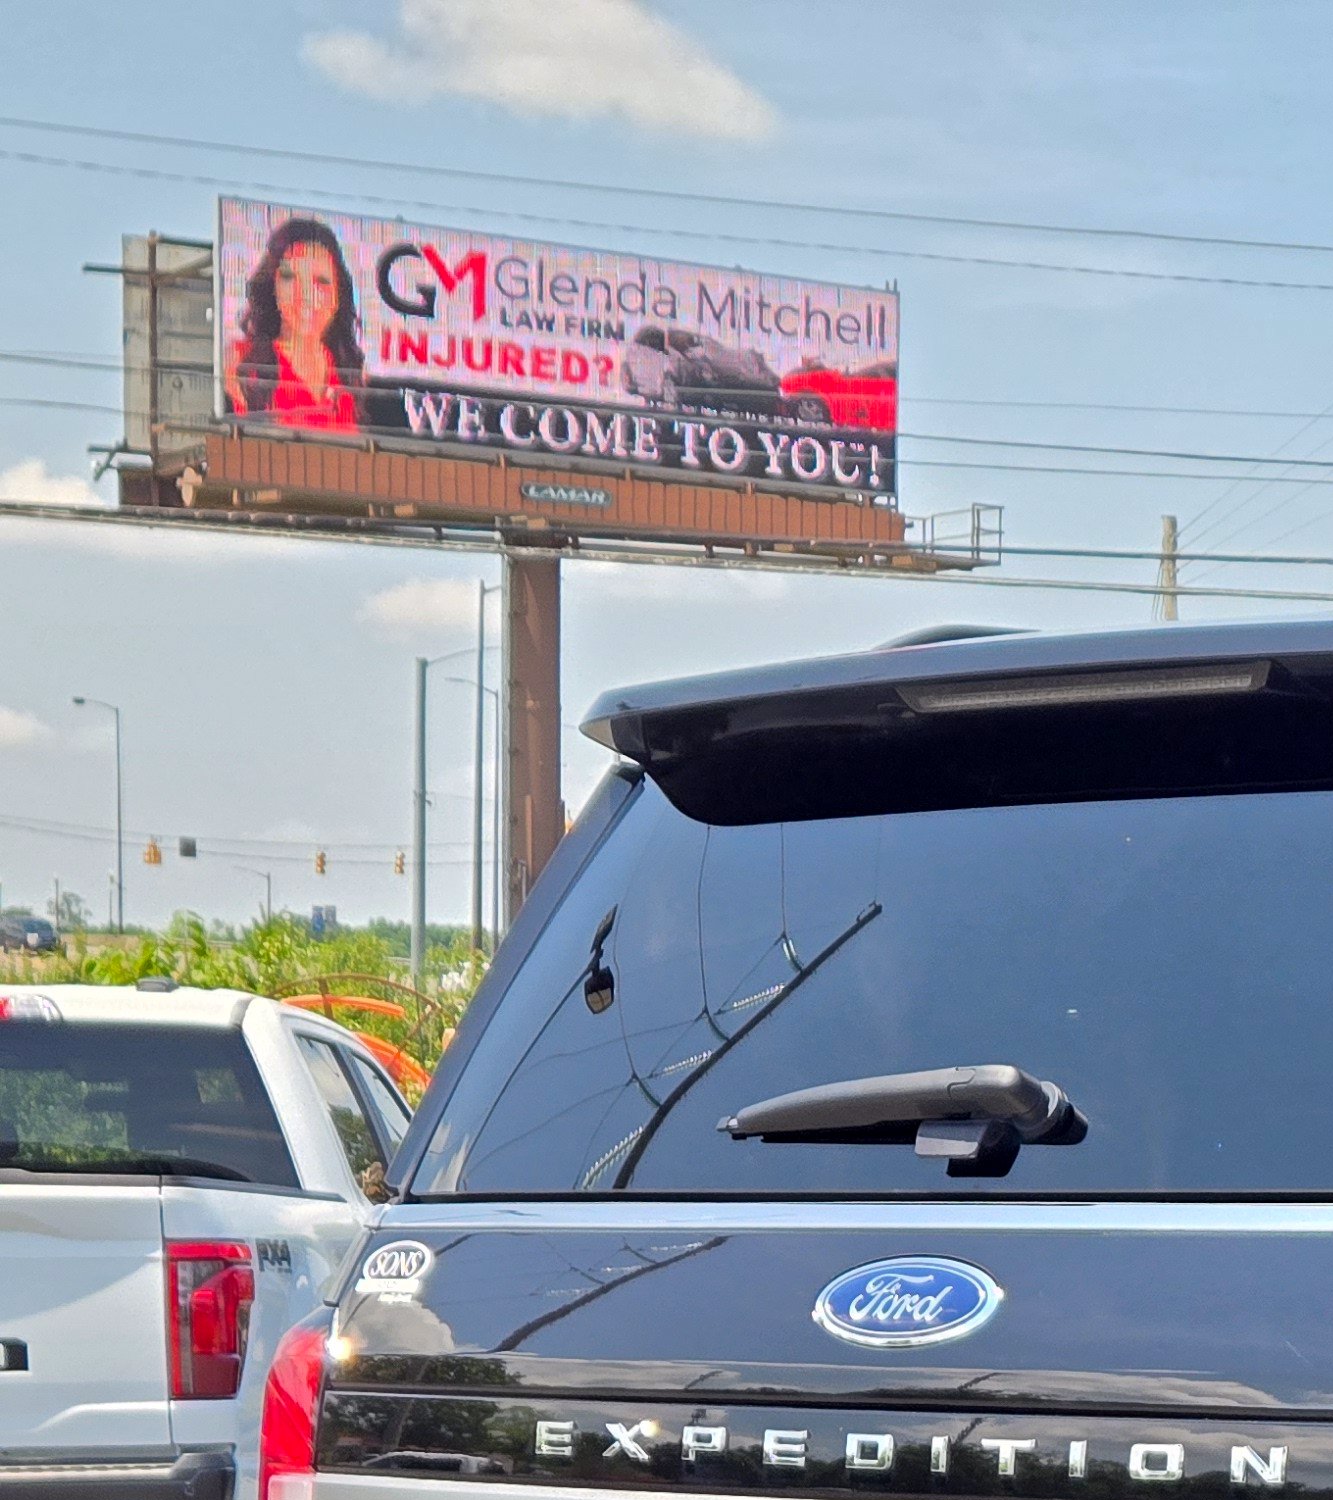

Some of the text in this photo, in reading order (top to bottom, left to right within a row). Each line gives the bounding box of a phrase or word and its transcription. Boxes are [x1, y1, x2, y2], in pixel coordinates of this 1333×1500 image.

[494, 255, 886, 349] Glenda Mitchell
[500, 306, 555, 333] LAW
[381, 328, 614, 386] INJURED?
[404, 390, 487, 438] WE
[500, 403, 660, 461] COME
[674, 419, 746, 471] TO
[757, 431, 881, 487] YOU!
[849, 1272, 953, 1321] Ford
[534, 1419, 1288, 1485] EXPEDITION
